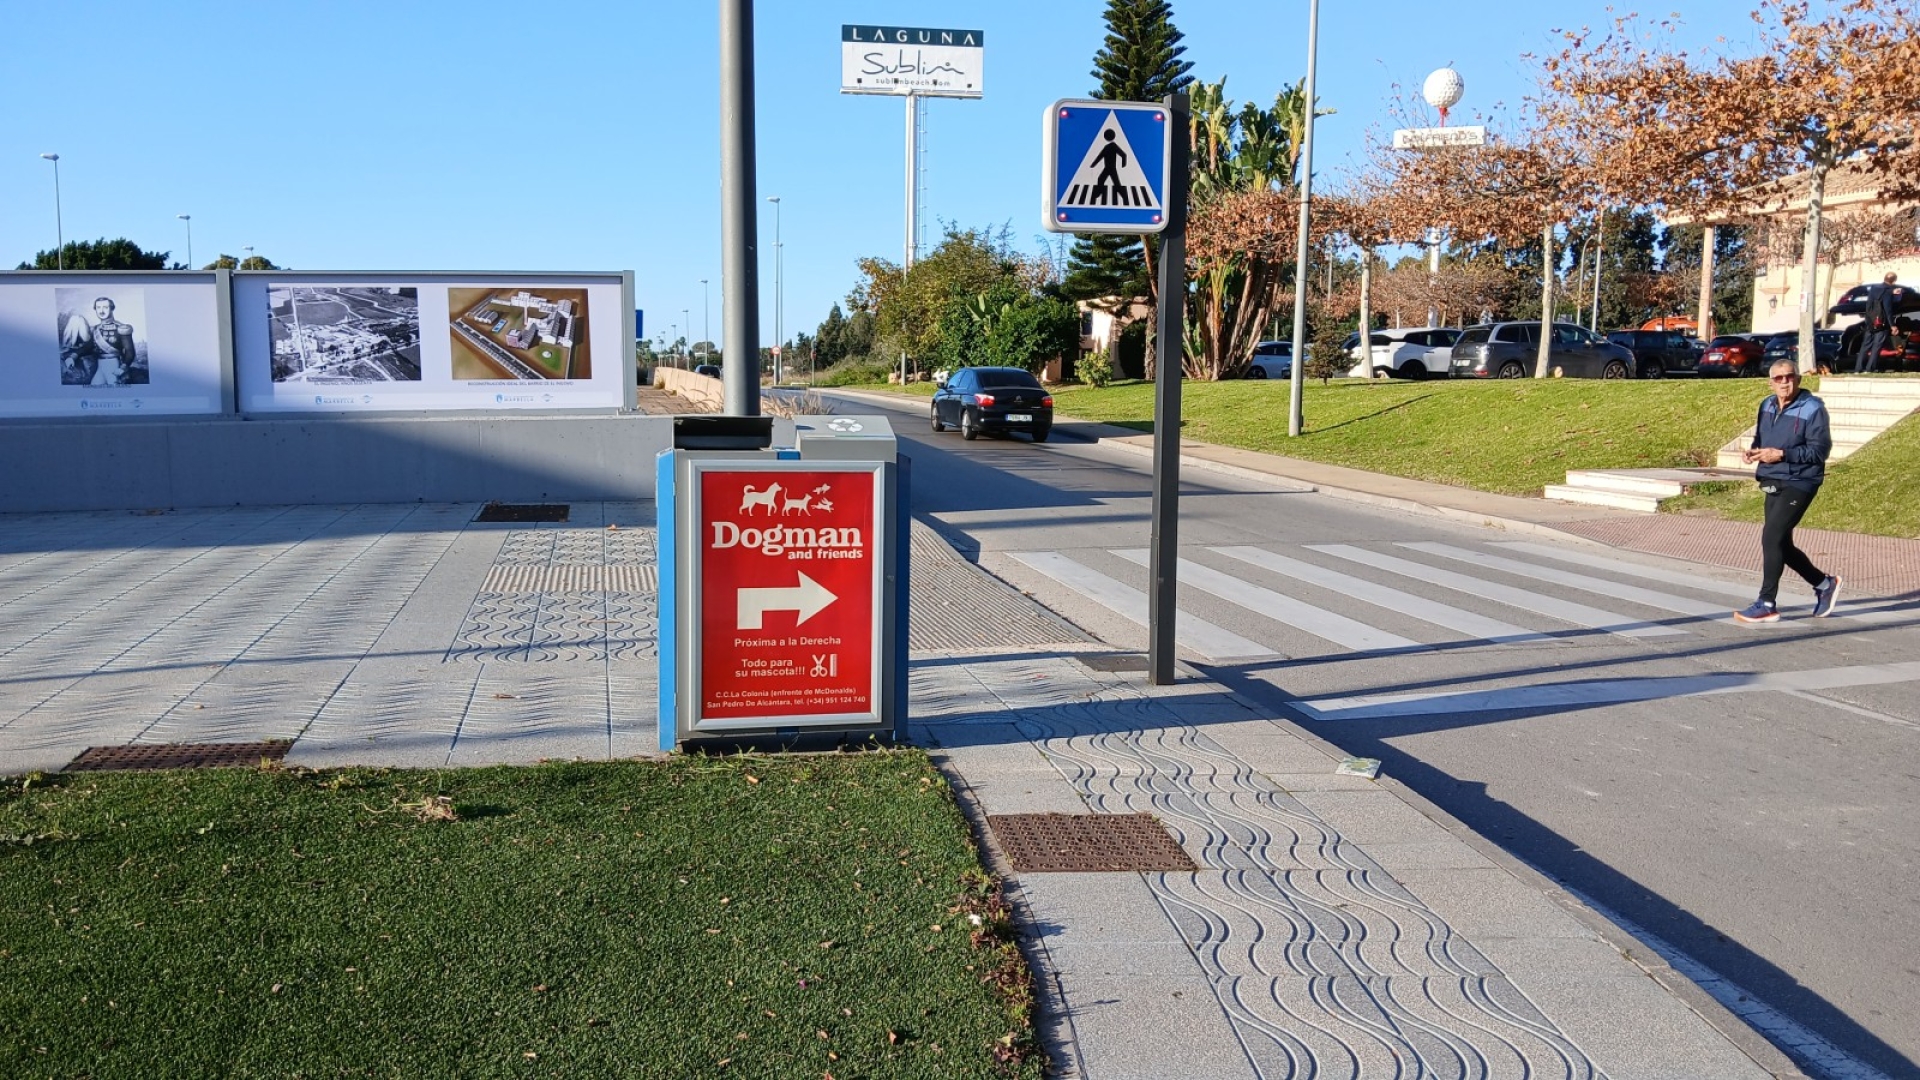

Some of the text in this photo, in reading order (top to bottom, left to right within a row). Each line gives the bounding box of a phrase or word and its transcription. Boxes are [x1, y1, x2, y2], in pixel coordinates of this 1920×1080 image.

[852, 27, 975, 46] LAGUNA
[711, 521, 864, 556] Dogman
[788, 549, 864, 560] and friends
[734, 635, 841, 648] Próxima a la Derecha
[741, 659, 793, 669] Todo para
[750, 666, 806, 677] mascota!!!
[770, 689, 803, 697] (enfrente
[803, 688, 814, 696] de
[814, 687, 857, 696] McDonalds)
[706, 701, 720, 709] San
[806, 697, 824, 706] (+34)
